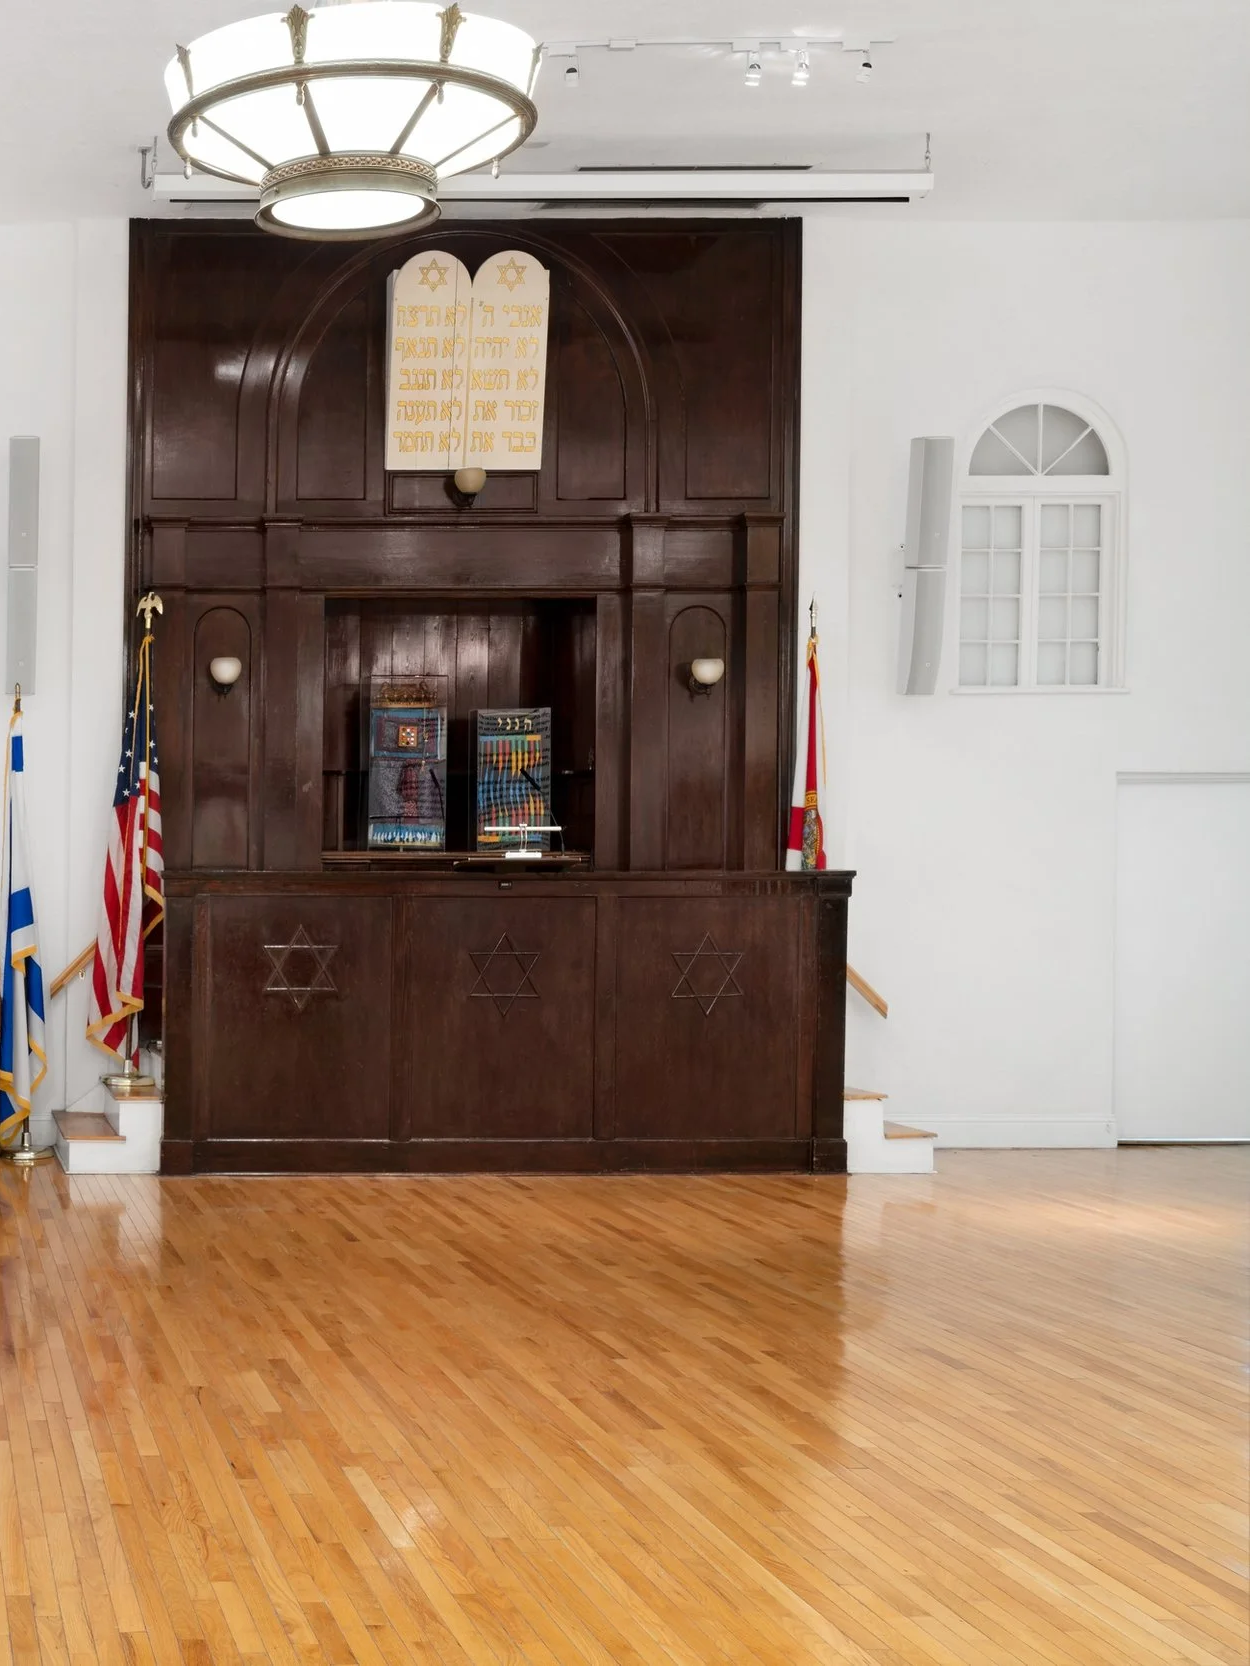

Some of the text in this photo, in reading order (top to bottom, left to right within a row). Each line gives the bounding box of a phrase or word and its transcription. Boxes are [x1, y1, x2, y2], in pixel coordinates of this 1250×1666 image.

[396, 301, 467, 327] לא תרצח
[502, 304, 542, 327] אנכי
[395, 333, 465, 362] לא תנאף
[474, 333, 539, 359] לא יהיה
[399, 364, 463, 390] לא תגנב
[471, 365, 539, 390] לא תשא
[396, 396, 462, 425] לא תענה
[473, 400, 539, 421] זכור את
[393, 427, 461, 453] לא תחמד
[470, 431, 536, 452] כבד את
